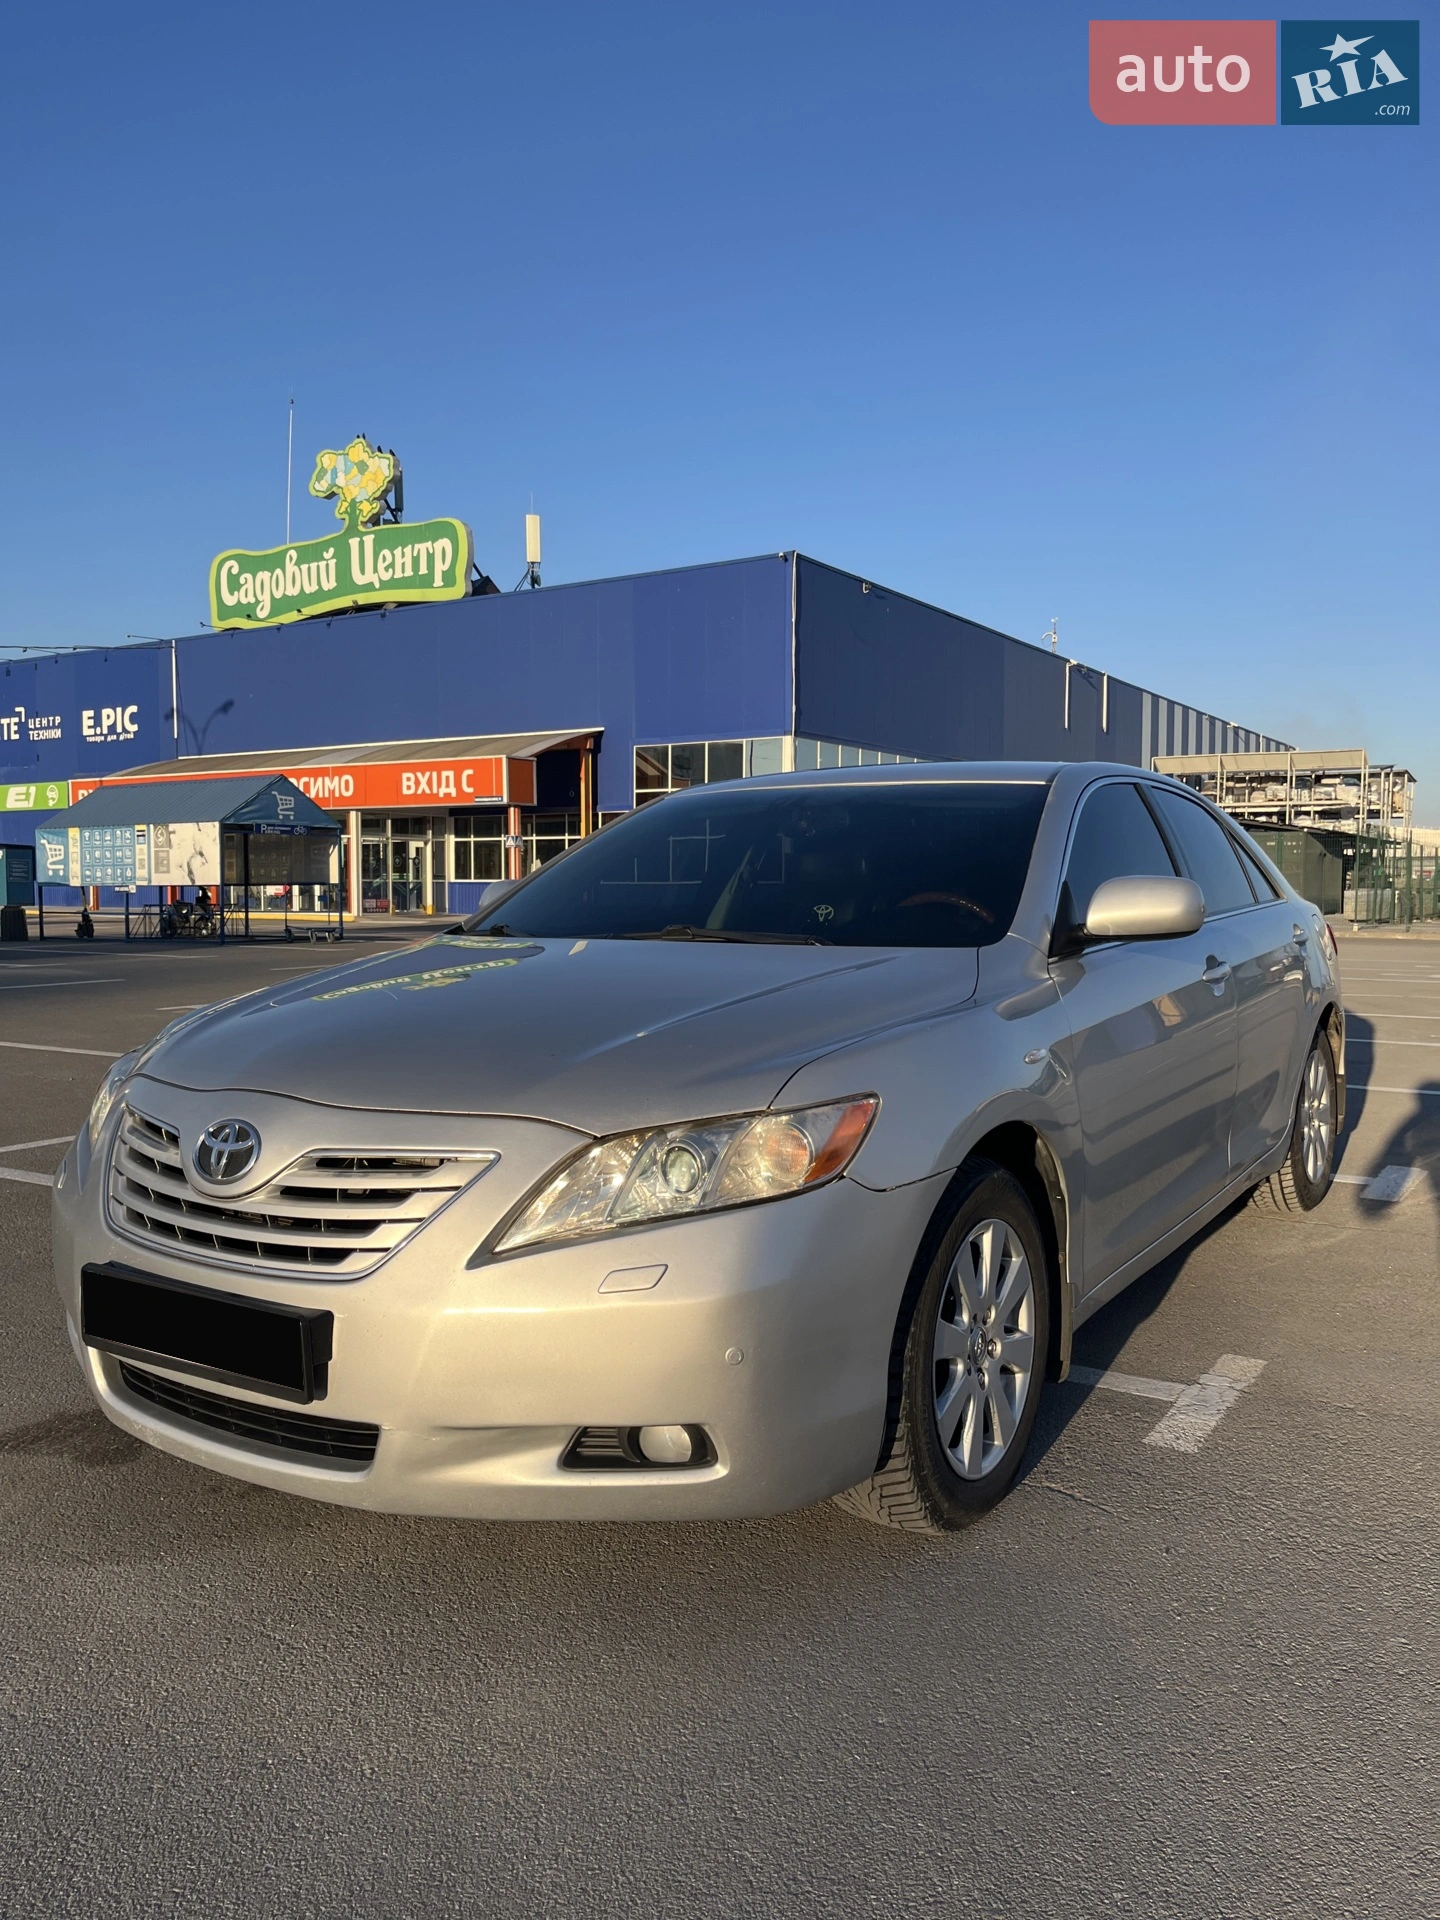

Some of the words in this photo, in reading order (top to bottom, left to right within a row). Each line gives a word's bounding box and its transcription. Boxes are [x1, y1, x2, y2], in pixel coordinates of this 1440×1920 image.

[219, 547, 338, 619] Садовий
[348, 534, 453, 589] Центр
[28, 716, 61, 728] ЦЕНТР
[28, 728, 61, 740] ТЕХНІКИ
[82, 705, 138, 736] E.PIC
[402, 770, 456, 798] ВХІД
